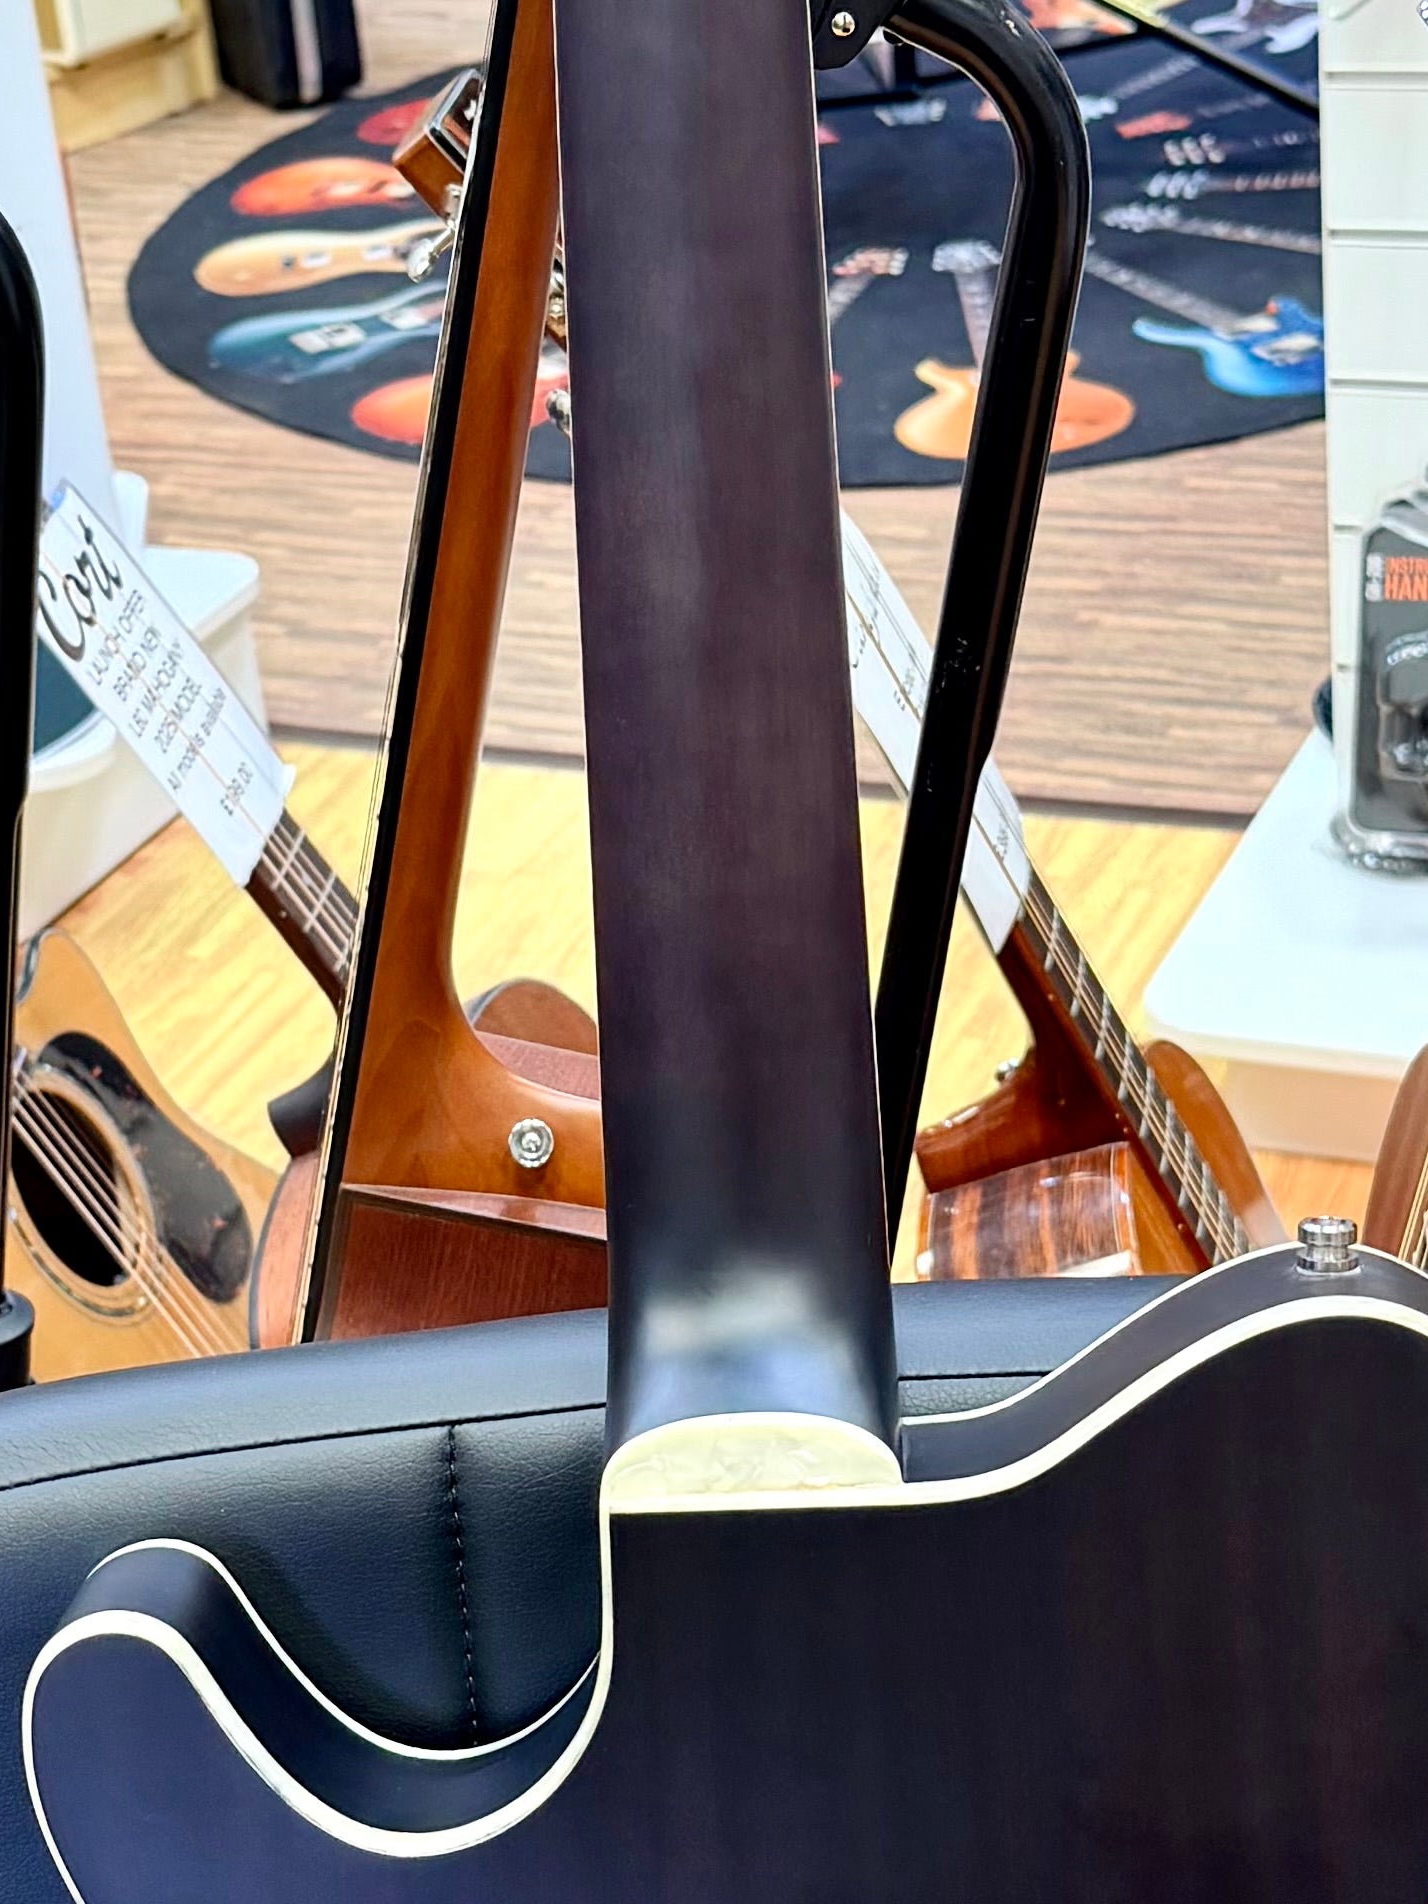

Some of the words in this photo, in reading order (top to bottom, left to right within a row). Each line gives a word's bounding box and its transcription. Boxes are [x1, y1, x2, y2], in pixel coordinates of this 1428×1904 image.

[37, 513, 124, 662] Cort
[86, 626, 125, 687] LAUNCH
[137, 623, 164, 659] NEW
[138, 638, 187, 716] MAHOGANY
[171, 674, 203, 723] MODEL
